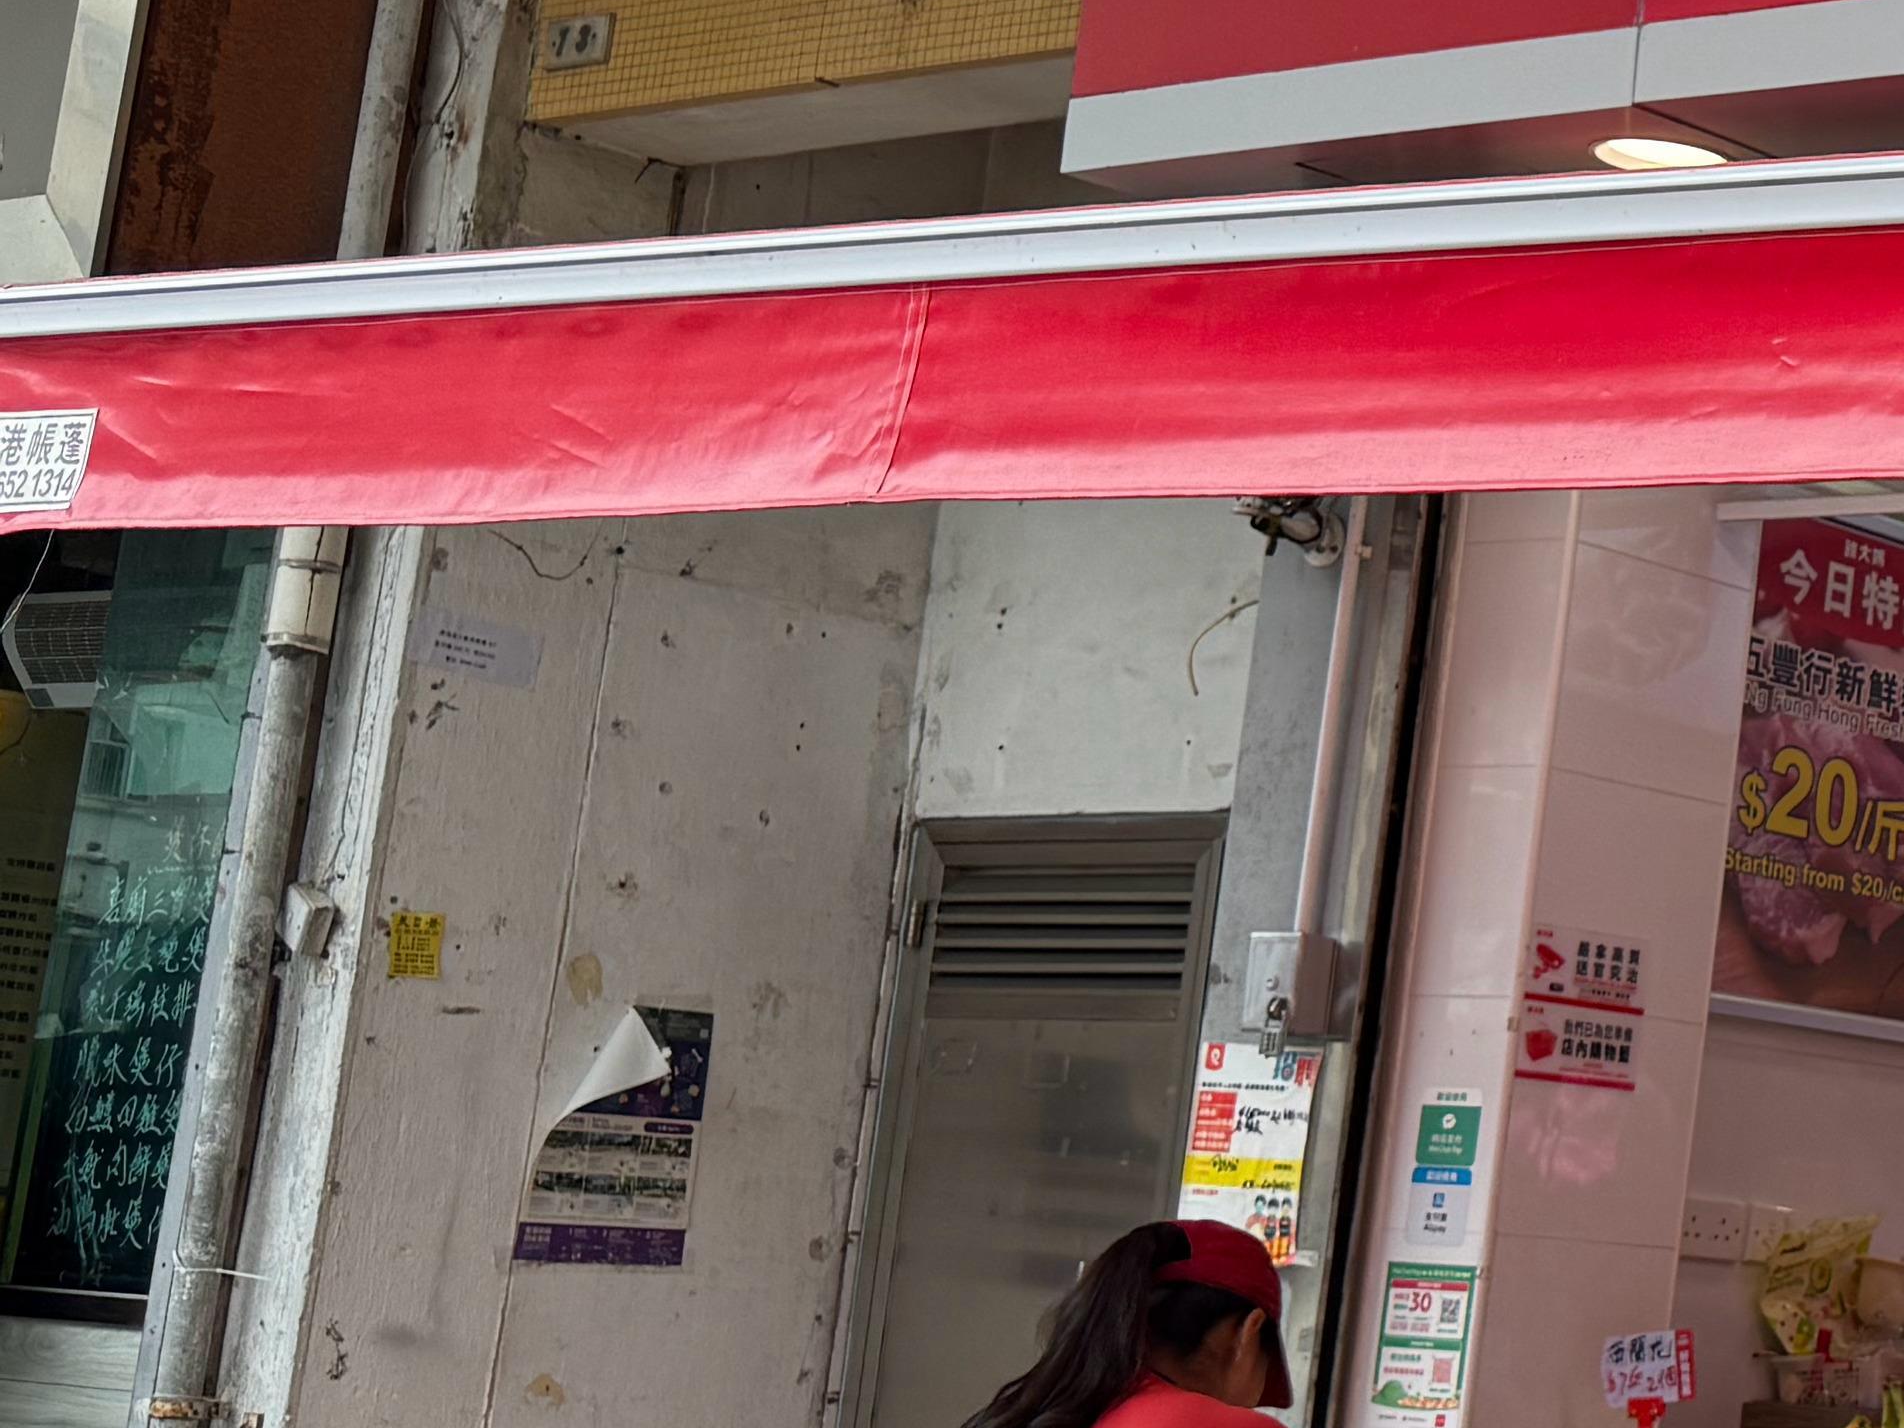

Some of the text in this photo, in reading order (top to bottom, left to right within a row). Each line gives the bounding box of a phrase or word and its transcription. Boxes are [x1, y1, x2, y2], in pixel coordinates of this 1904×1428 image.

[32, 468, 77, 498] 1314
[1770, 688, 1814, 721] Fung
[1816, 702, 1861, 734] Hong
[1803, 861, 1846, 893] from
